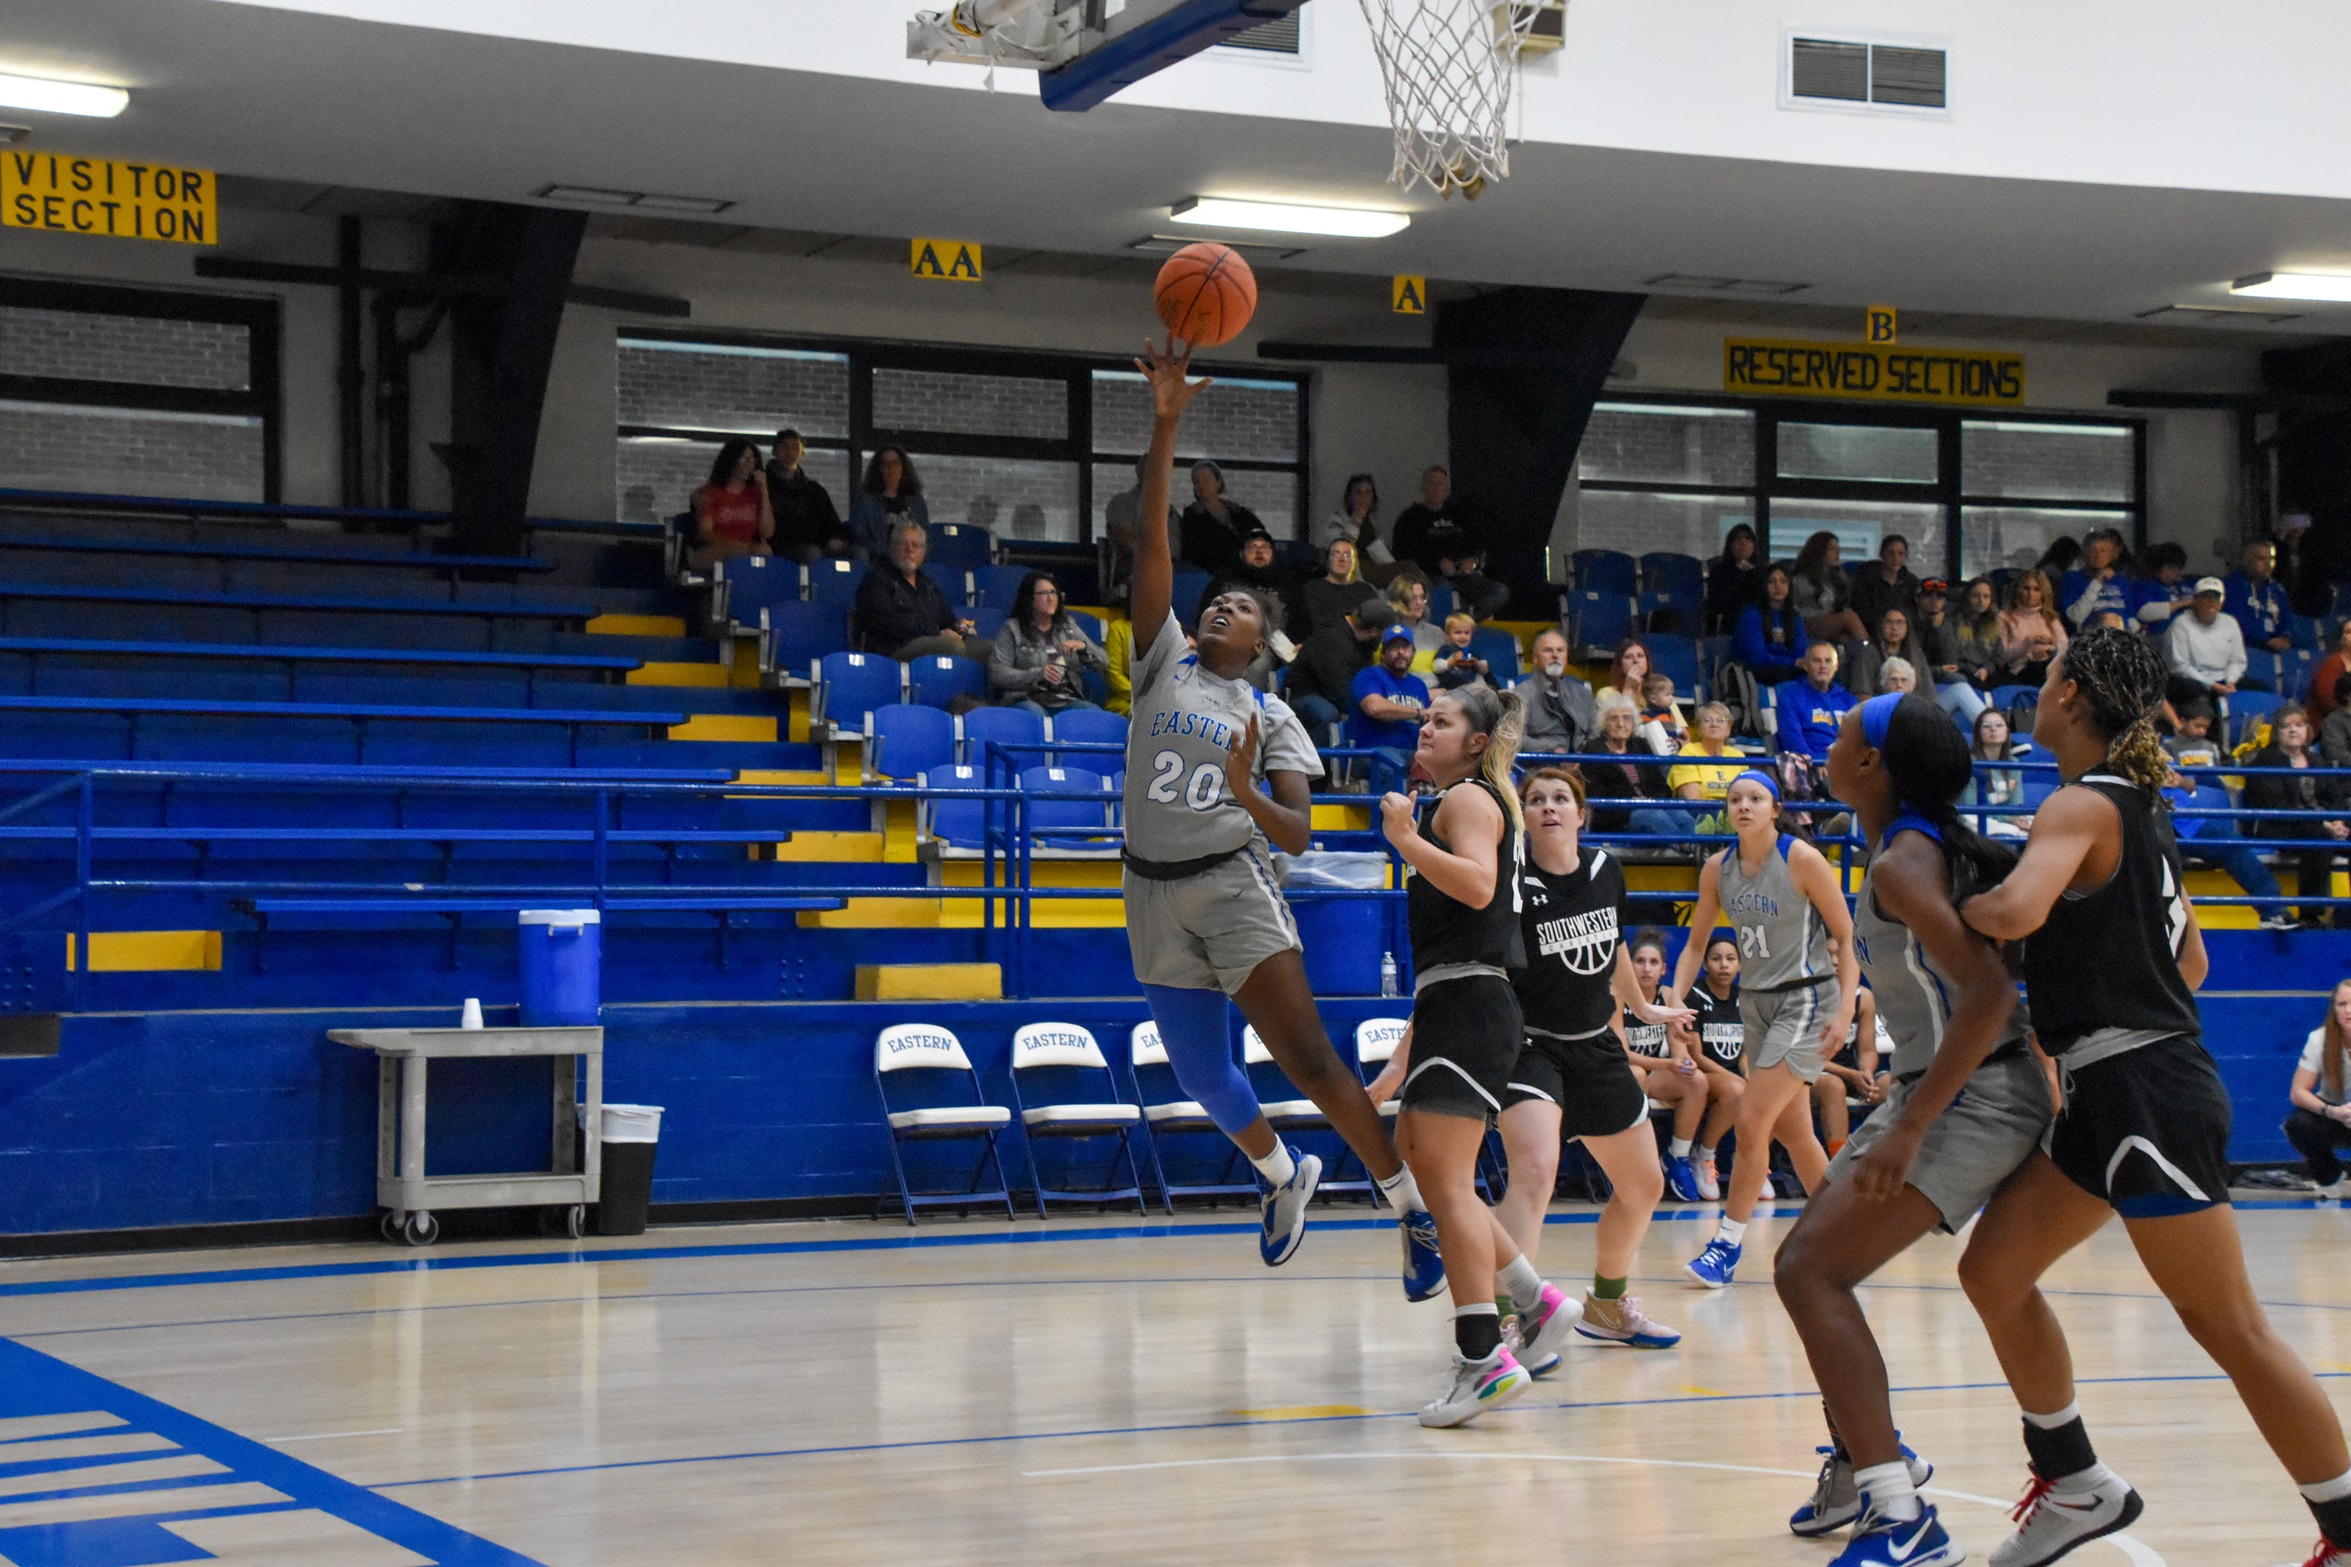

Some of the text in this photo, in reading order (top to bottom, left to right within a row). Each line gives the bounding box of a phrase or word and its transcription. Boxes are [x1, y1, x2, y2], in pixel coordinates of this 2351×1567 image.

[14, 153, 203, 203] VISITOR
[15, 194, 204, 241] SECTION
[913, 242, 981, 278] AA
[1396, 279, 1424, 311] A
[1871, 312, 1894, 341] B
[1729, 345, 2022, 399] RESERVED SECTIONS
[1150, 710, 1247, 752] EASTE
[1147, 749, 1226, 812] 20
[1728, 893, 1779, 917] ASTERN
[1740, 924, 1771, 959] 21
[887, 1035, 952, 1053] EASTERN
[1022, 1033, 1088, 1050] EASTERN
[1365, 1027, 1404, 1043] EASTE
